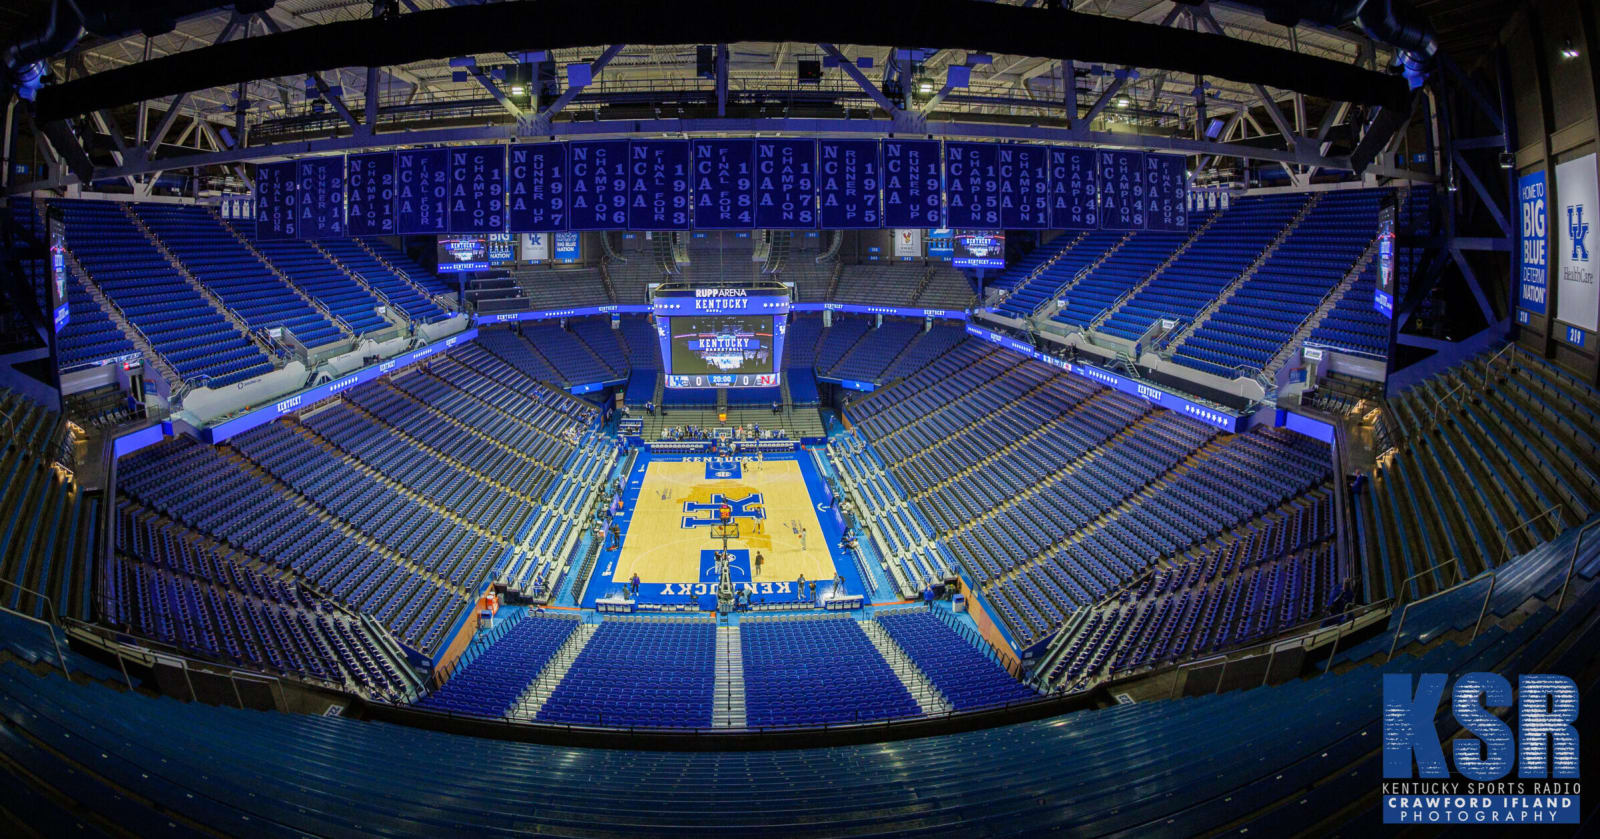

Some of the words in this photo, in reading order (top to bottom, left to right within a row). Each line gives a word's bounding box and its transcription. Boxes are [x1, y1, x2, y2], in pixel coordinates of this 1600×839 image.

[302, 164, 313, 219] NCAA
[318, 167, 326, 209] RUNNER
[351, 160, 361, 216] NCAA
[400, 156, 413, 213] NCAA
[420, 159, 429, 193] FINAL
[454, 153, 466, 212] NCAA
[473, 156, 484, 227] CHAMPION
[513, 150, 527, 211] NCAA
[533, 154, 544, 200] RUNNER
[574, 148, 588, 208] NCAA
[595, 149, 607, 222] CHAMPION
[633, 147, 648, 208] NCAA
[654, 150, 665, 186] FINAL
[698, 145, 713, 207] NCAA
[718, 148, 731, 184] FINAL
[738, 162, 751, 223] 1984
[760, 144, 775, 206] NCAA
[782, 148, 794, 220] CHAMPION
[799, 162, 813, 223] 1978
[824, 146, 839, 207] NCAA
[845, 150, 857, 197] RUNNER
[864, 162, 877, 222] 1975
[887, 144, 902, 205] NCAA
[909, 150, 920, 197] RUNNER
[927, 164, 939, 222] 1966
[950, 148, 963, 208] NCAA
[970, 151, 982, 221] CHAMPION
[1000, 150, 1013, 209] NCAA
[1019, 154, 1031, 221] CHAMPION
[1054, 152, 1067, 208] NCAA
[1071, 156, 1081, 222] CHAMPION
[1104, 154, 1115, 208] NCAA
[1119, 158, 1129, 223] CHAMPION
[1148, 158, 1159, 212] NCAA
[1163, 163, 1171, 193] FINAL
[1523, 184, 1536, 200] HOME
[1536, 182, 1544, 198] TO
[259, 169, 269, 222] NCAA
[273, 206, 281, 232] FOUR
[285, 181, 294, 234] 2015
[331, 178, 341, 232] 2014
[367, 161, 376, 227] CHAMPION
[382, 174, 393, 230] 2012
[420, 197, 429, 225] FOUR
[434, 172, 445, 229] 2011
[489, 168, 501, 228] 1998
[534, 208, 544, 224] UP
[550, 166, 563, 226] 1997
[613, 164, 626, 224] 1996
[654, 192, 665, 221] FOUR
[673, 164, 686, 225] 1993
[719, 191, 731, 220] FOUR
[846, 204, 857, 220] UP
[910, 204, 920, 219] UP
[986, 166, 998, 223] 1958
[1036, 168, 1047, 224] 1951
[1086, 171, 1096, 225] 1949
[1134, 172, 1143, 225] 1948
[1164, 200, 1172, 224] FOUR
[1176, 175, 1185, 227] 1942
[1524, 200, 1545, 238] BIG
[318, 217, 326, 229] UP
[1524, 240, 1545, 266] BLUE
[1524, 267, 1544, 284] DETERMI
[1564, 266, 1594, 285] HealthCare
[696, 289, 718, 298] RUPP
[718, 289, 747, 297] ARENA
[696, 299, 748, 309] KENTUCKY
[700, 339, 749, 348] KENTUCKY
[1570, 328, 1581, 345] 219
[278, 396, 302, 413] KENTUCKY
[696, 376, 702, 386] 0
[744, 376, 748, 385] 0
[1138, 384, 1161, 401] KENTUCKY
[660, 583, 792, 595] KENUCKY
